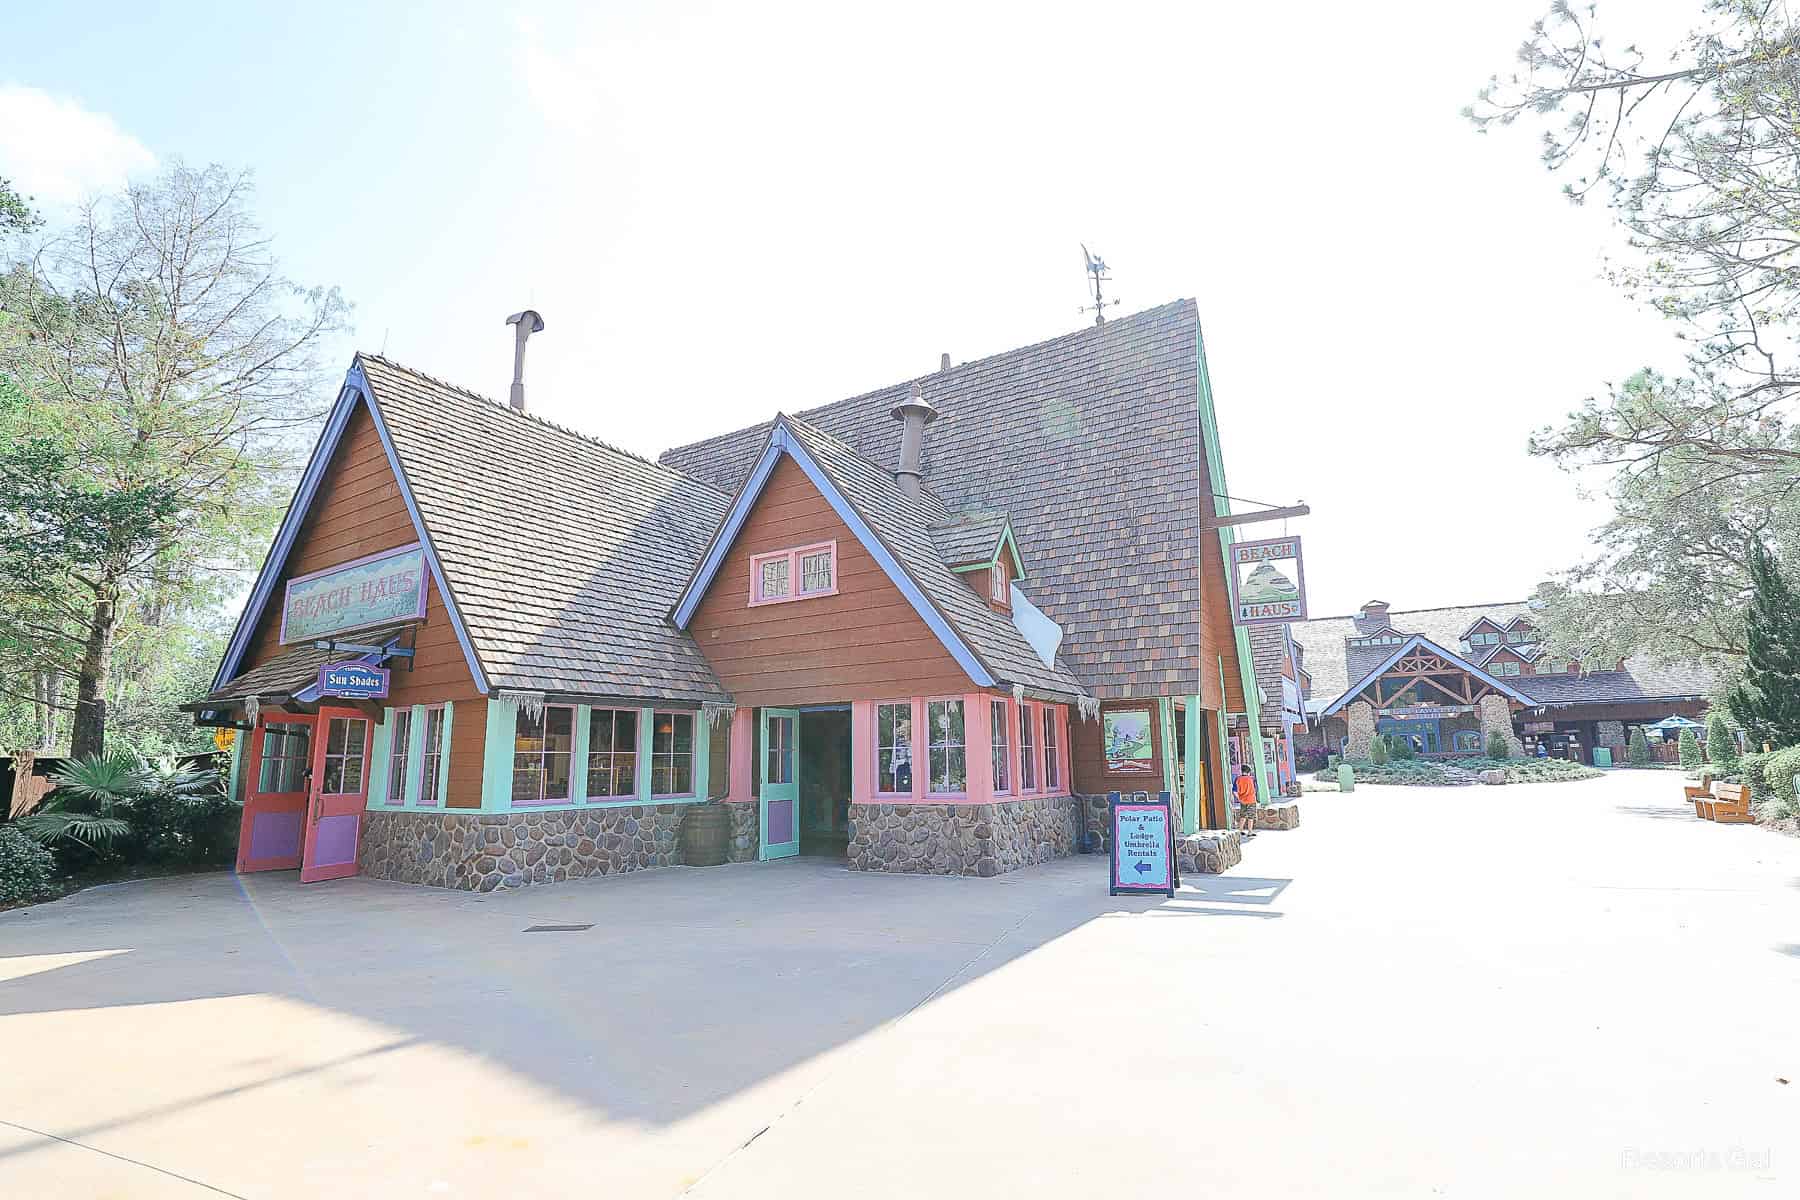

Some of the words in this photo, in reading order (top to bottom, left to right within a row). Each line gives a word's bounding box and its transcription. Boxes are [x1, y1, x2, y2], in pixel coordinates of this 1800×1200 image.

[1240, 544, 1292, 561] BEACH
[293, 584, 353, 618] BEACH
[359, 570, 416, 607] HAUS
[1250, 603, 1291, 617] HAUS
[329, 674, 347, 685] Sun
[349, 675, 379, 687] Shades
[1130, 832, 1154, 841] Lodge
[1124, 840, 1160, 848] Umbrella
[1128, 849, 1157, 857] Rentals
